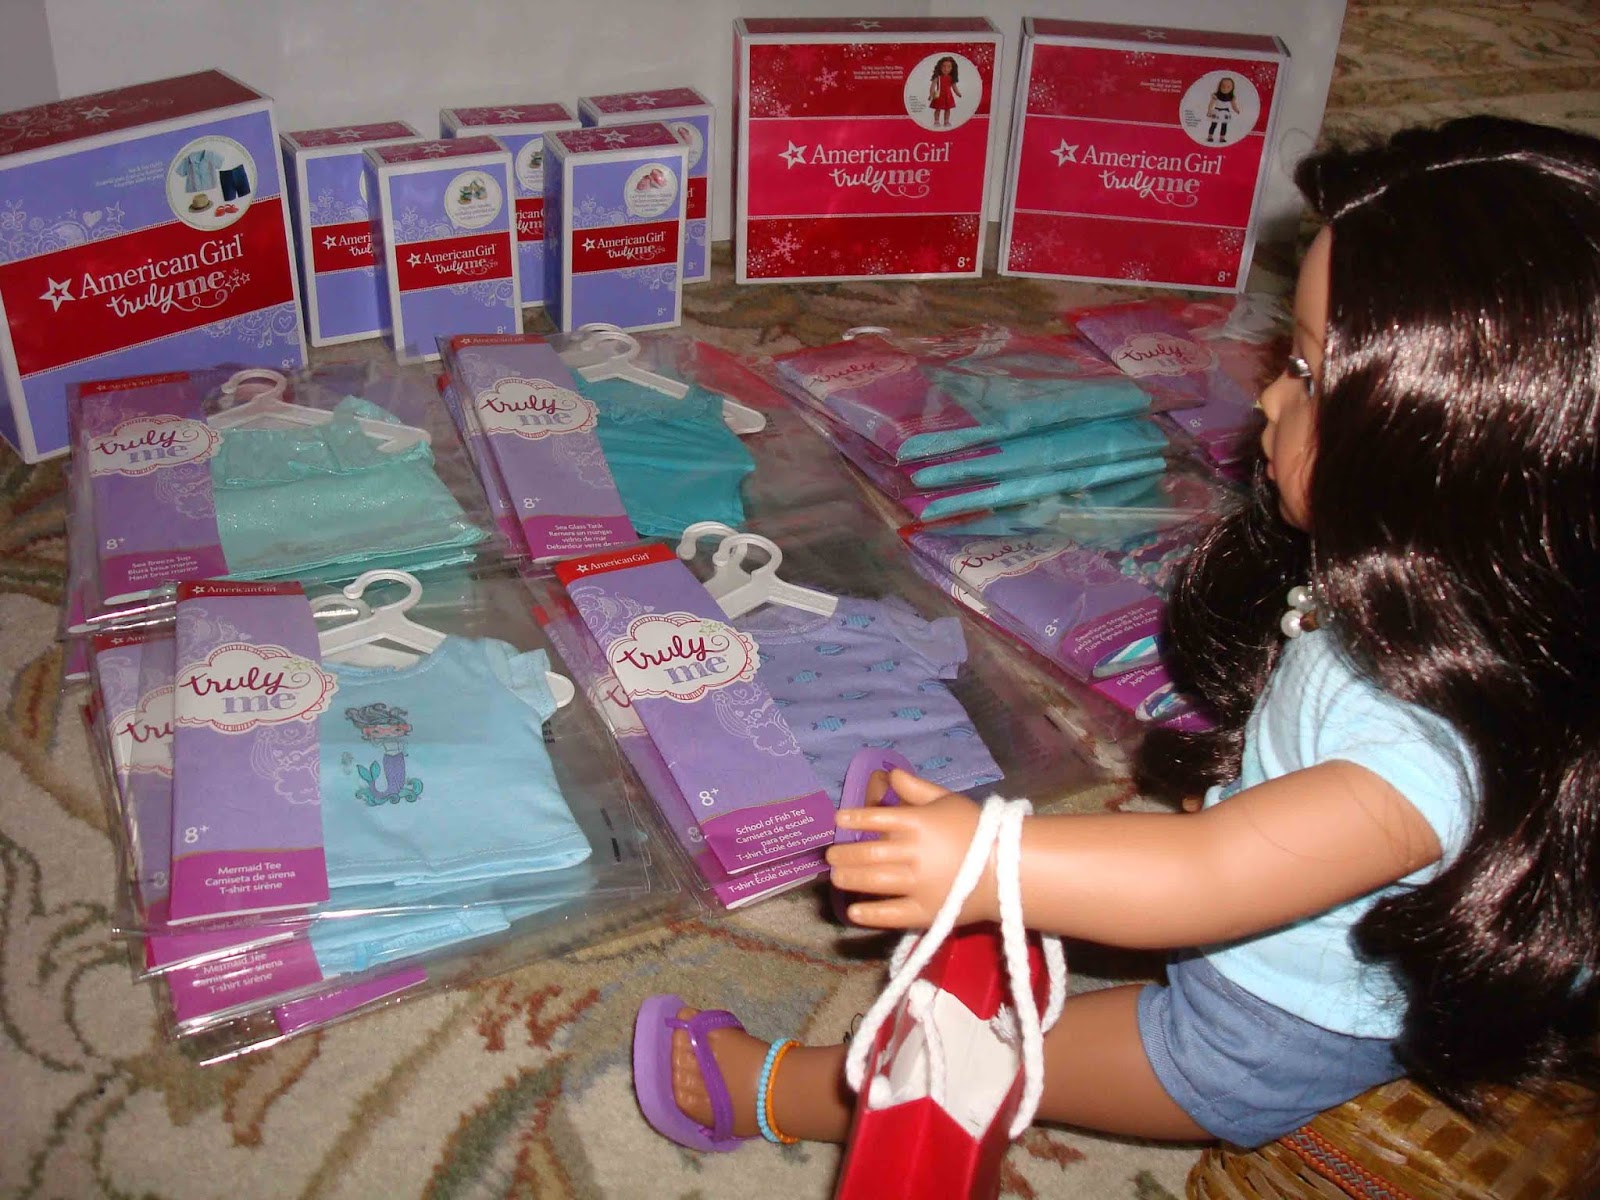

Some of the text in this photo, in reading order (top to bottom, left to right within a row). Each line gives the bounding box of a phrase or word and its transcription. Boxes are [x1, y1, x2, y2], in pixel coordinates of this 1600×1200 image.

[810, 142, 949, 165] American Girl
[1080, 145, 1223, 175] American Girl
[829, 165, 887, 194] truly
[1098, 170, 1156, 198] truly
[348, 243, 374, 257] trul
[597, 231, 665, 249] American Girl
[423, 244, 496, 264] American Girl
[79, 234, 244, 299] American Girl
[106, 284, 175, 317] truly
[480, 394, 557, 414] truly
[516, 411, 572, 427] me
[92, 429, 176, 455] truly
[129, 444, 188, 463] me
[589, 553, 650, 571] American Girl
[617, 635, 709, 670] truly
[180, 667, 285, 696] truly
[663, 655, 730, 685] me
[222, 691, 297, 715] me
[699, 787, 719, 807] 8+
[735, 808, 806, 836] School of Fish Tee
[736, 815, 815, 845] Camiseta de escuela
[184, 825, 210, 844] 8+
[736, 851, 763, 862] T-shirt
[787, 839, 802, 849] des
[802, 829, 835, 845] poissons
[760, 830, 803, 850] para peces
[205, 869, 296, 887] Camiseta de sirena
[218, 861, 282, 875] Mermaid Tee
[728, 881, 756, 893] T-shirt
[778, 868, 794, 877] des
[794, 859, 825, 875] poisson
[220, 884, 251, 895] T-shirt
[209, 981, 241, 994] T-shirt
